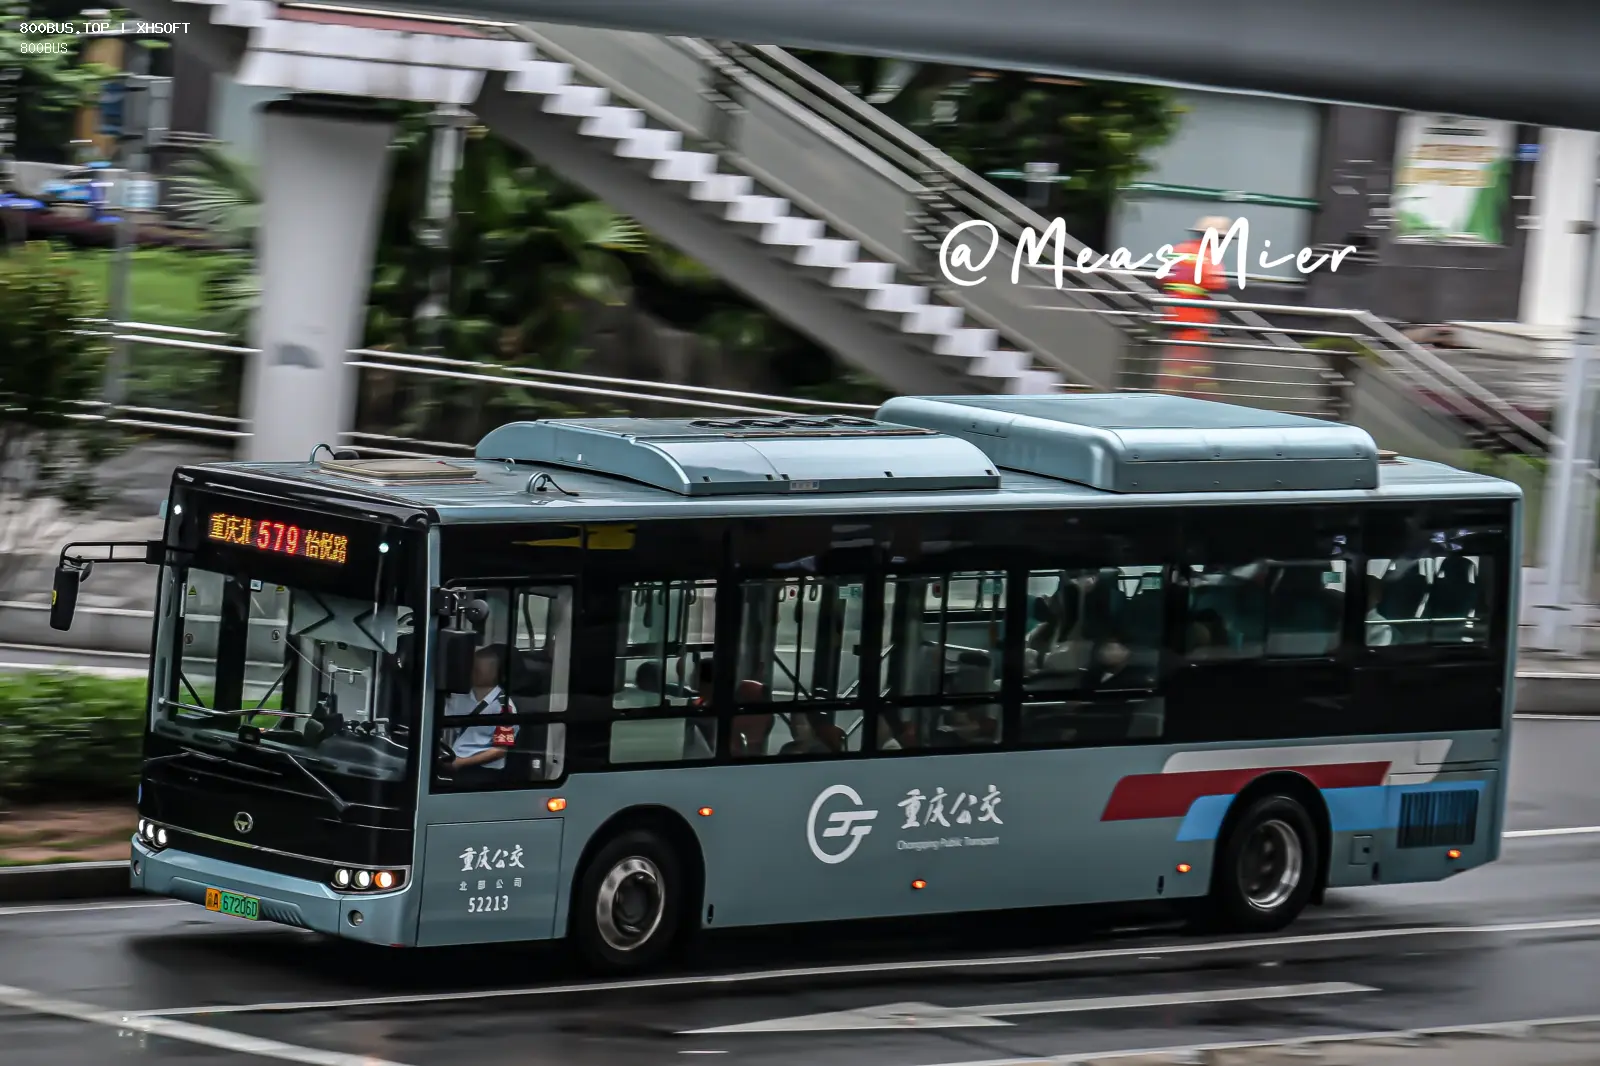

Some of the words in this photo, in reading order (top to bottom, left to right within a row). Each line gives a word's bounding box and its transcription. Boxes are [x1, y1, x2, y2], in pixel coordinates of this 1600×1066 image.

[208, 513, 251, 545] 重庆北
[257, 520, 299, 554] 579
[896, 784, 1004, 829] 重庆公交
[459, 844, 525, 872] 重庆公交
[467, 895, 509, 913] 52213
